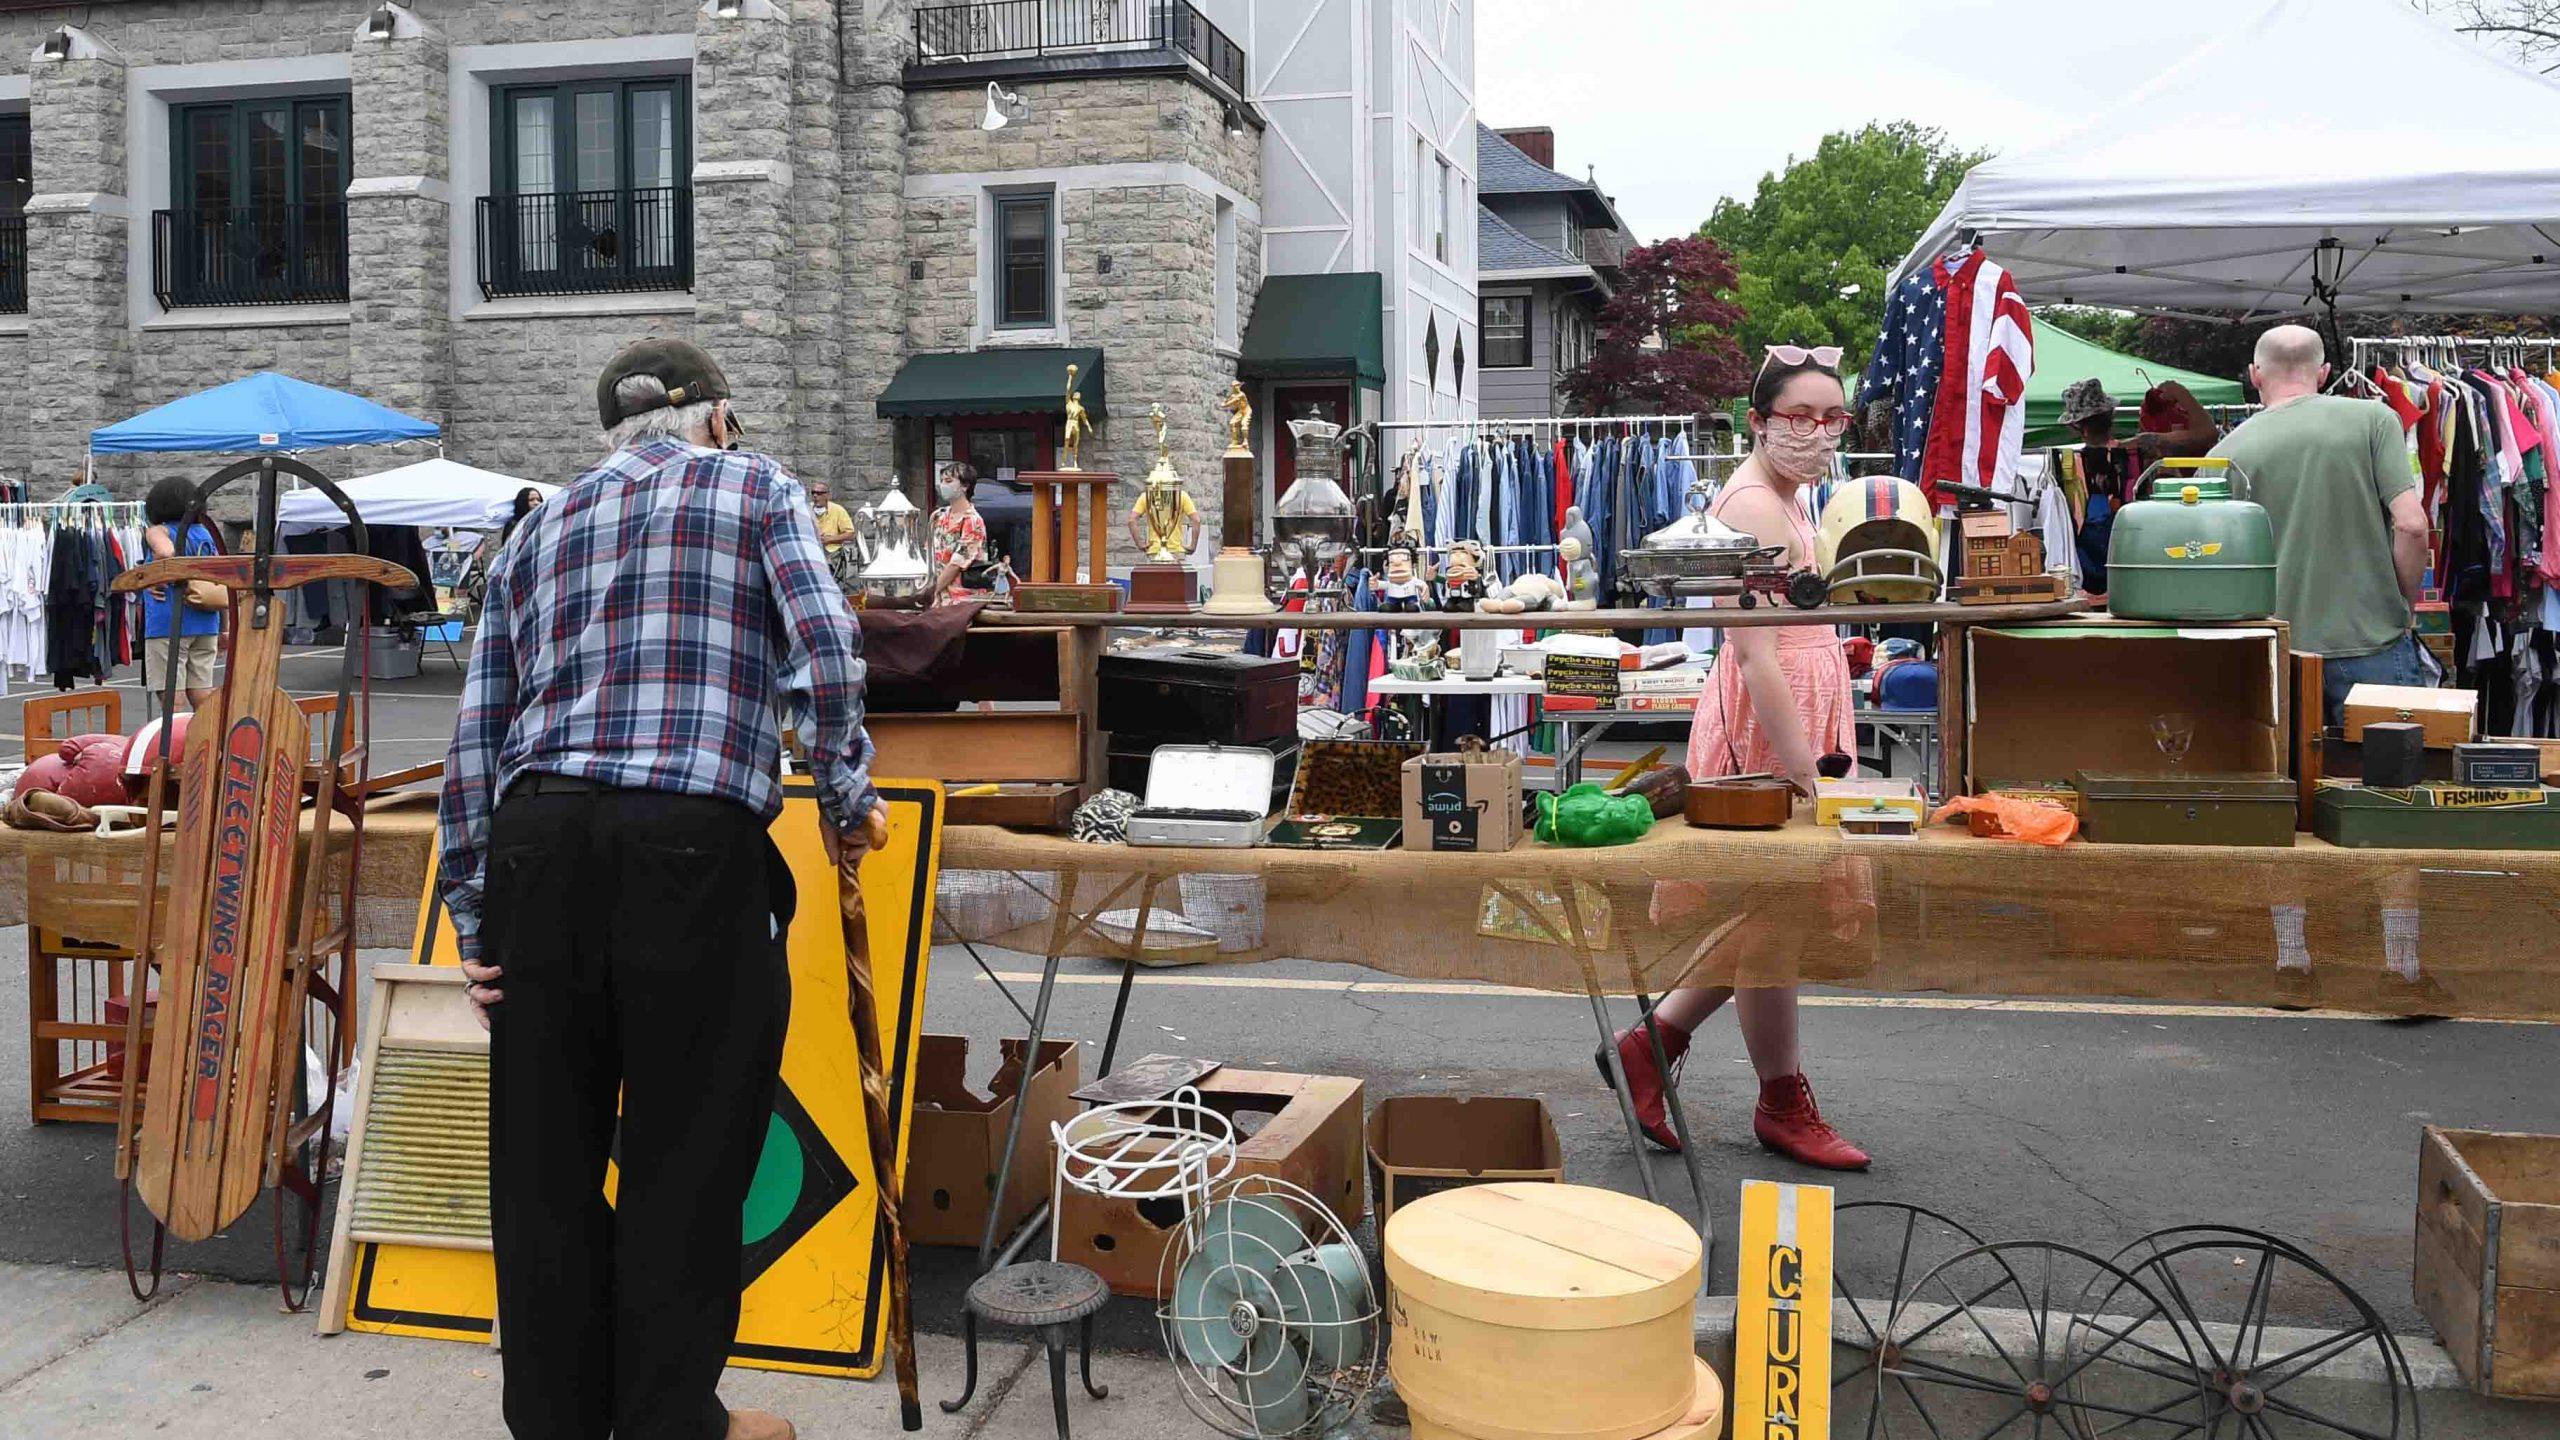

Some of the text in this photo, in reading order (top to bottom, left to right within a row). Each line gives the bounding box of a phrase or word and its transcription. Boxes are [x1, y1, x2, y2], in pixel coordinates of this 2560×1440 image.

[2443, 791, 2509, 806] FISHING
[1427, 800, 1462, 814] prime
[198, 754, 257, 1079] FLEETWING RACER
